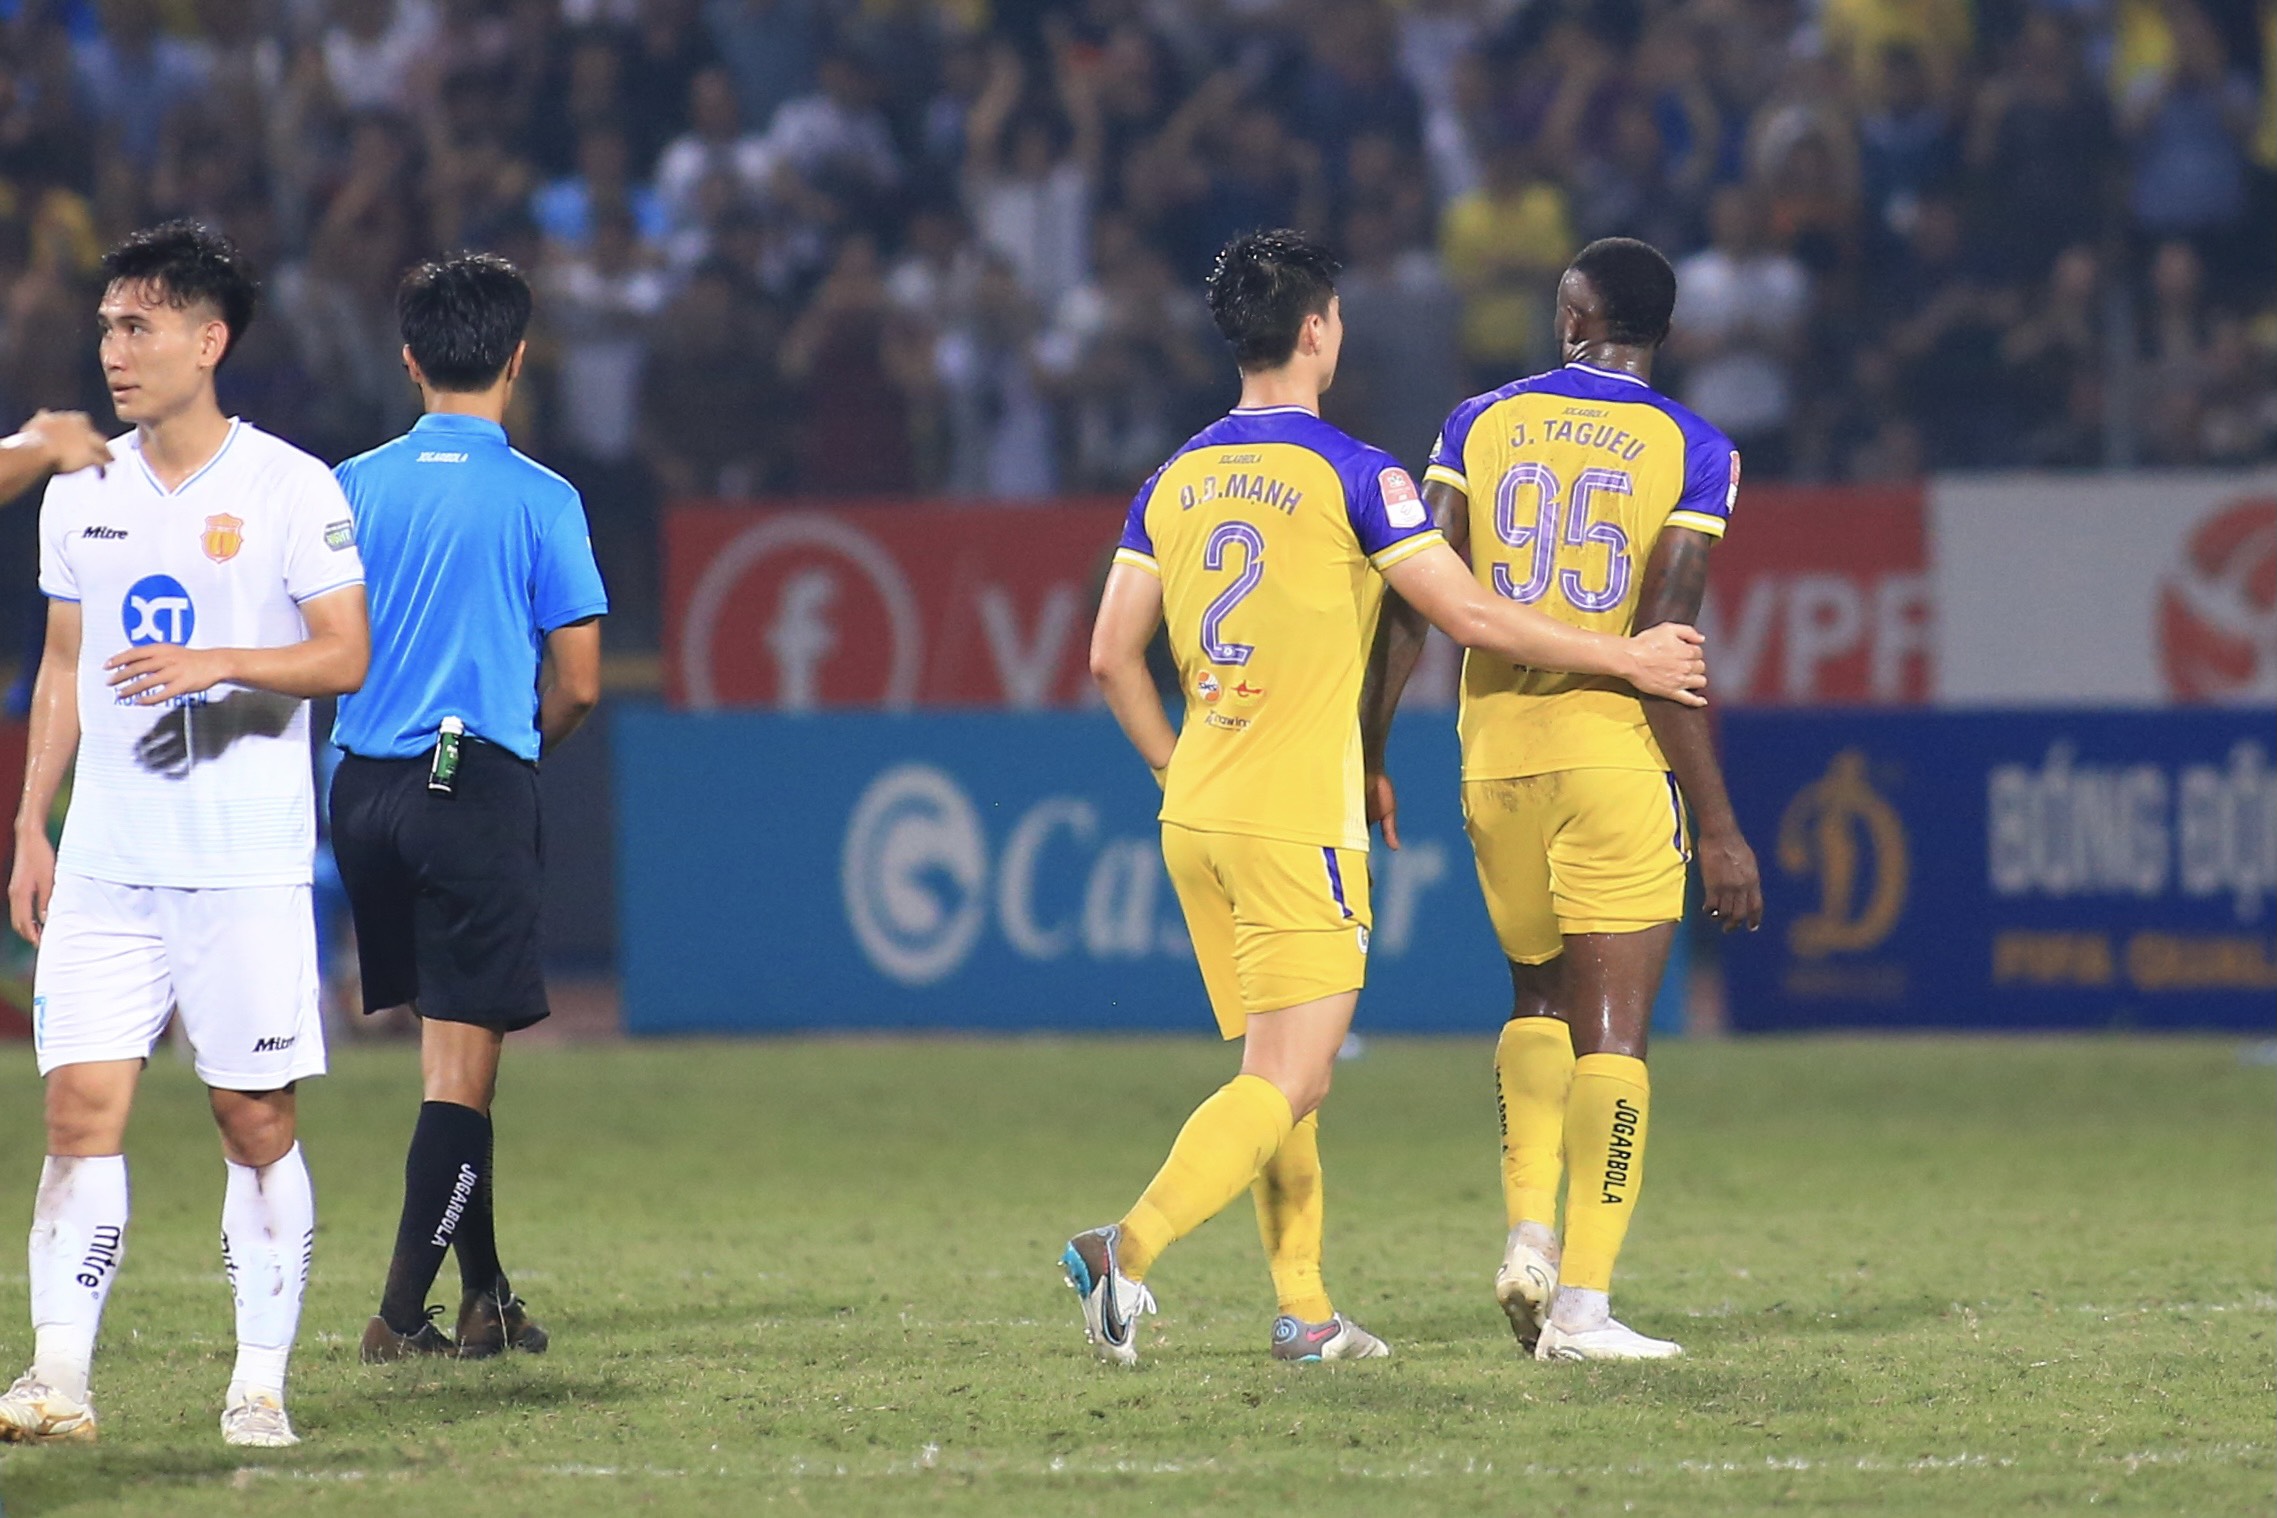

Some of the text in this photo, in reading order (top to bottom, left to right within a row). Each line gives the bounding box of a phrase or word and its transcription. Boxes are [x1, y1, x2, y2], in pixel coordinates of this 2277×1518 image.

[1510, 420, 1647, 461] J. TAGUEU
[82, 526, 129, 541] Mitre
[1491, 462, 1633, 613] 95
[1200, 520, 1265, 666] 2
[1000, 796, 1446, 960] Car
[1601, 1098, 1640, 1205] JOGARBOLA
[431, 1162, 478, 1248] JOGARBOLA
[76, 1225, 121, 1289] mitre
